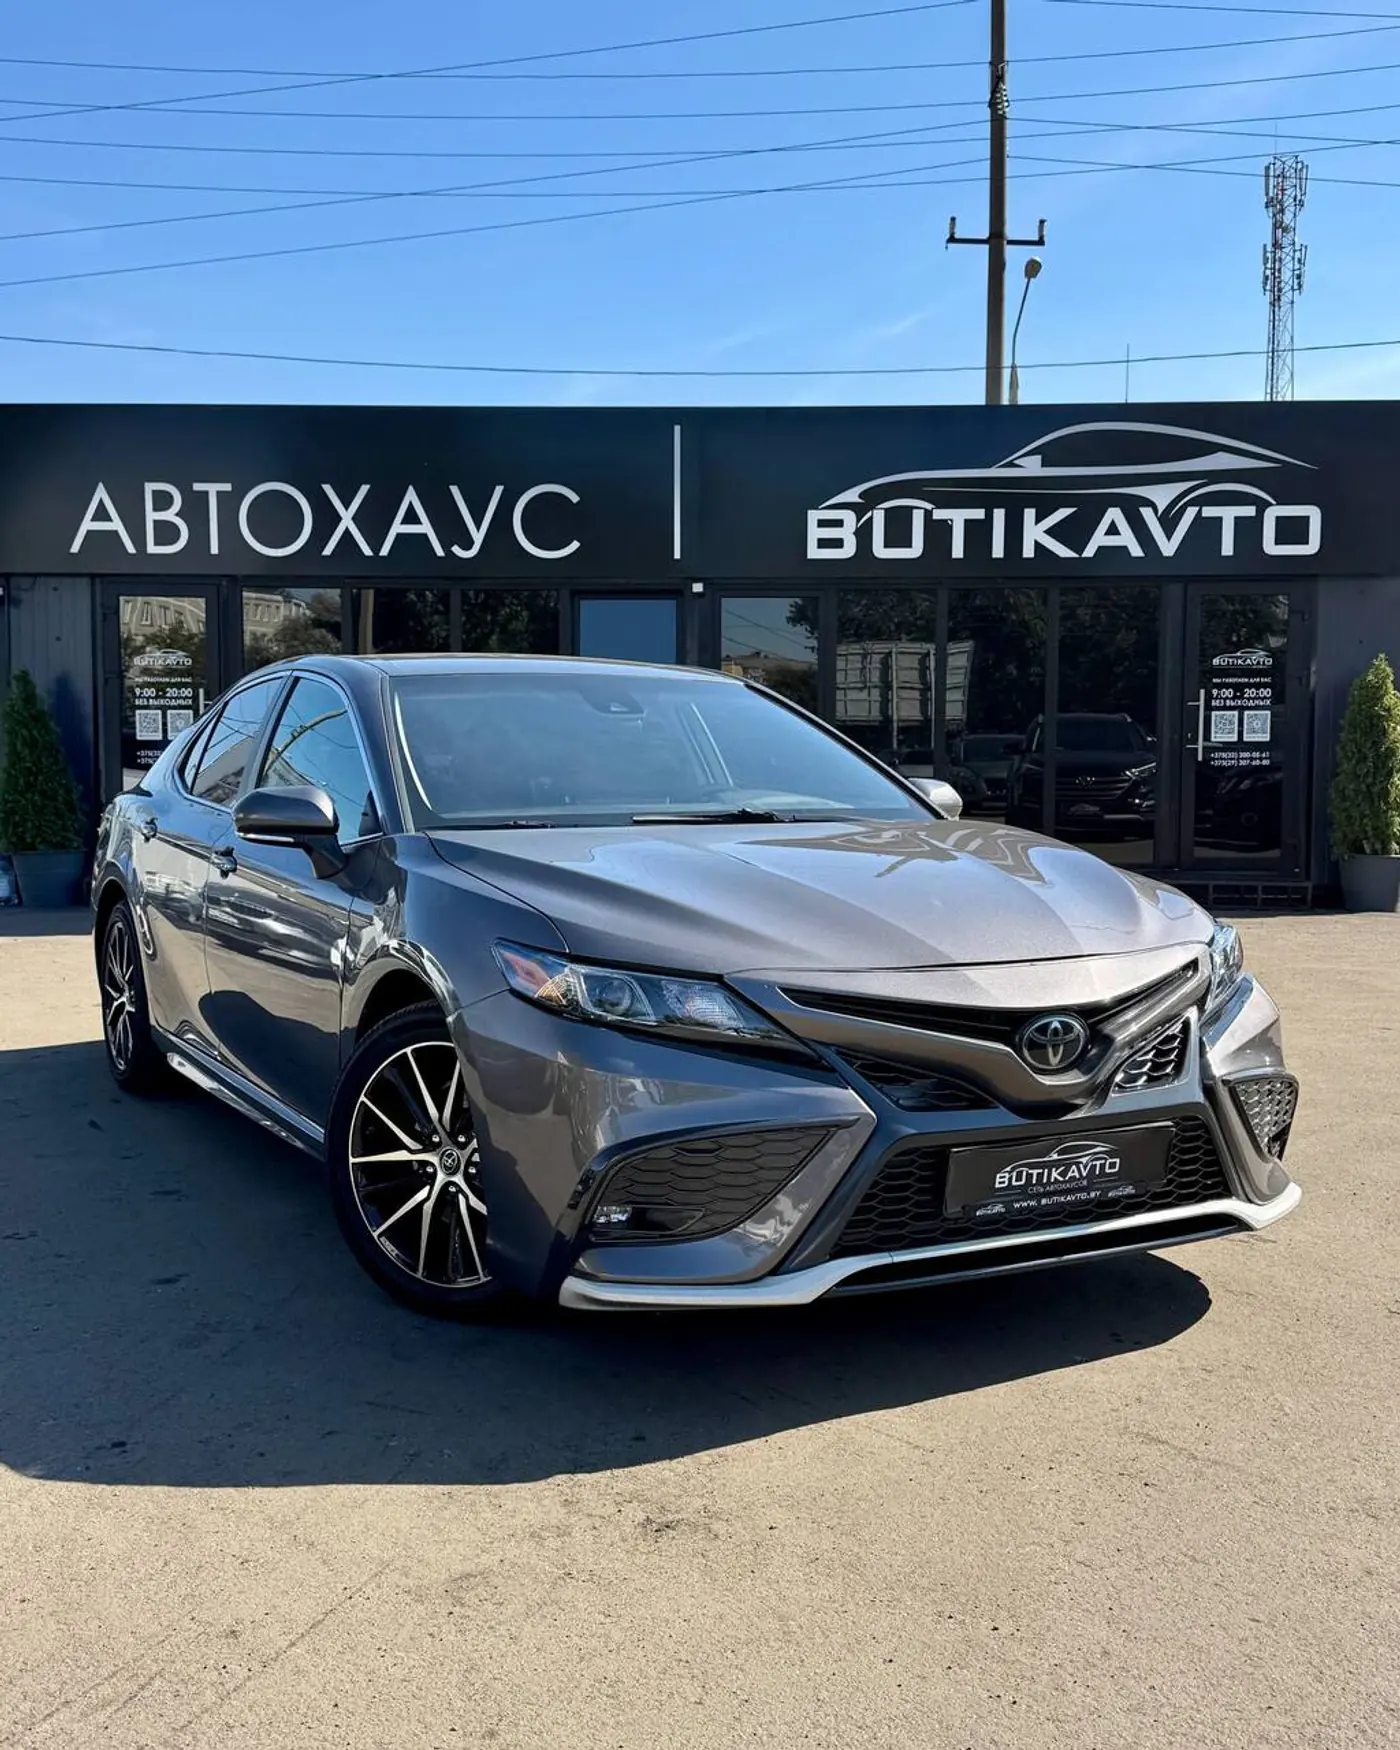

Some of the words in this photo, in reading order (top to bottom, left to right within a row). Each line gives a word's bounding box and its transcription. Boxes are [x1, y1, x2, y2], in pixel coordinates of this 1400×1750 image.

[70, 481, 582, 560] АВТОХАУС
[806, 504, 1322, 559] BUTIKAVTO
[1212, 657, 1273, 666] BUTIKAVTO
[134, 688, 156, 697] 9:00
[165, 688, 193, 697] 20:00
[1211, 688, 1234, 698] 9:00
[1243, 688, 1272, 698] 20:00
[149, 698, 193, 706] ВЫХОДНЫХ
[1211, 699, 1225, 707] БЕЗ
[1226, 699, 1272, 707] ВЫХОДНЫХ
[994, 1157, 1120, 1188] BUTIKAVTO
[1040, 1190, 1102, 1205] BUTIKAVTO.BY
